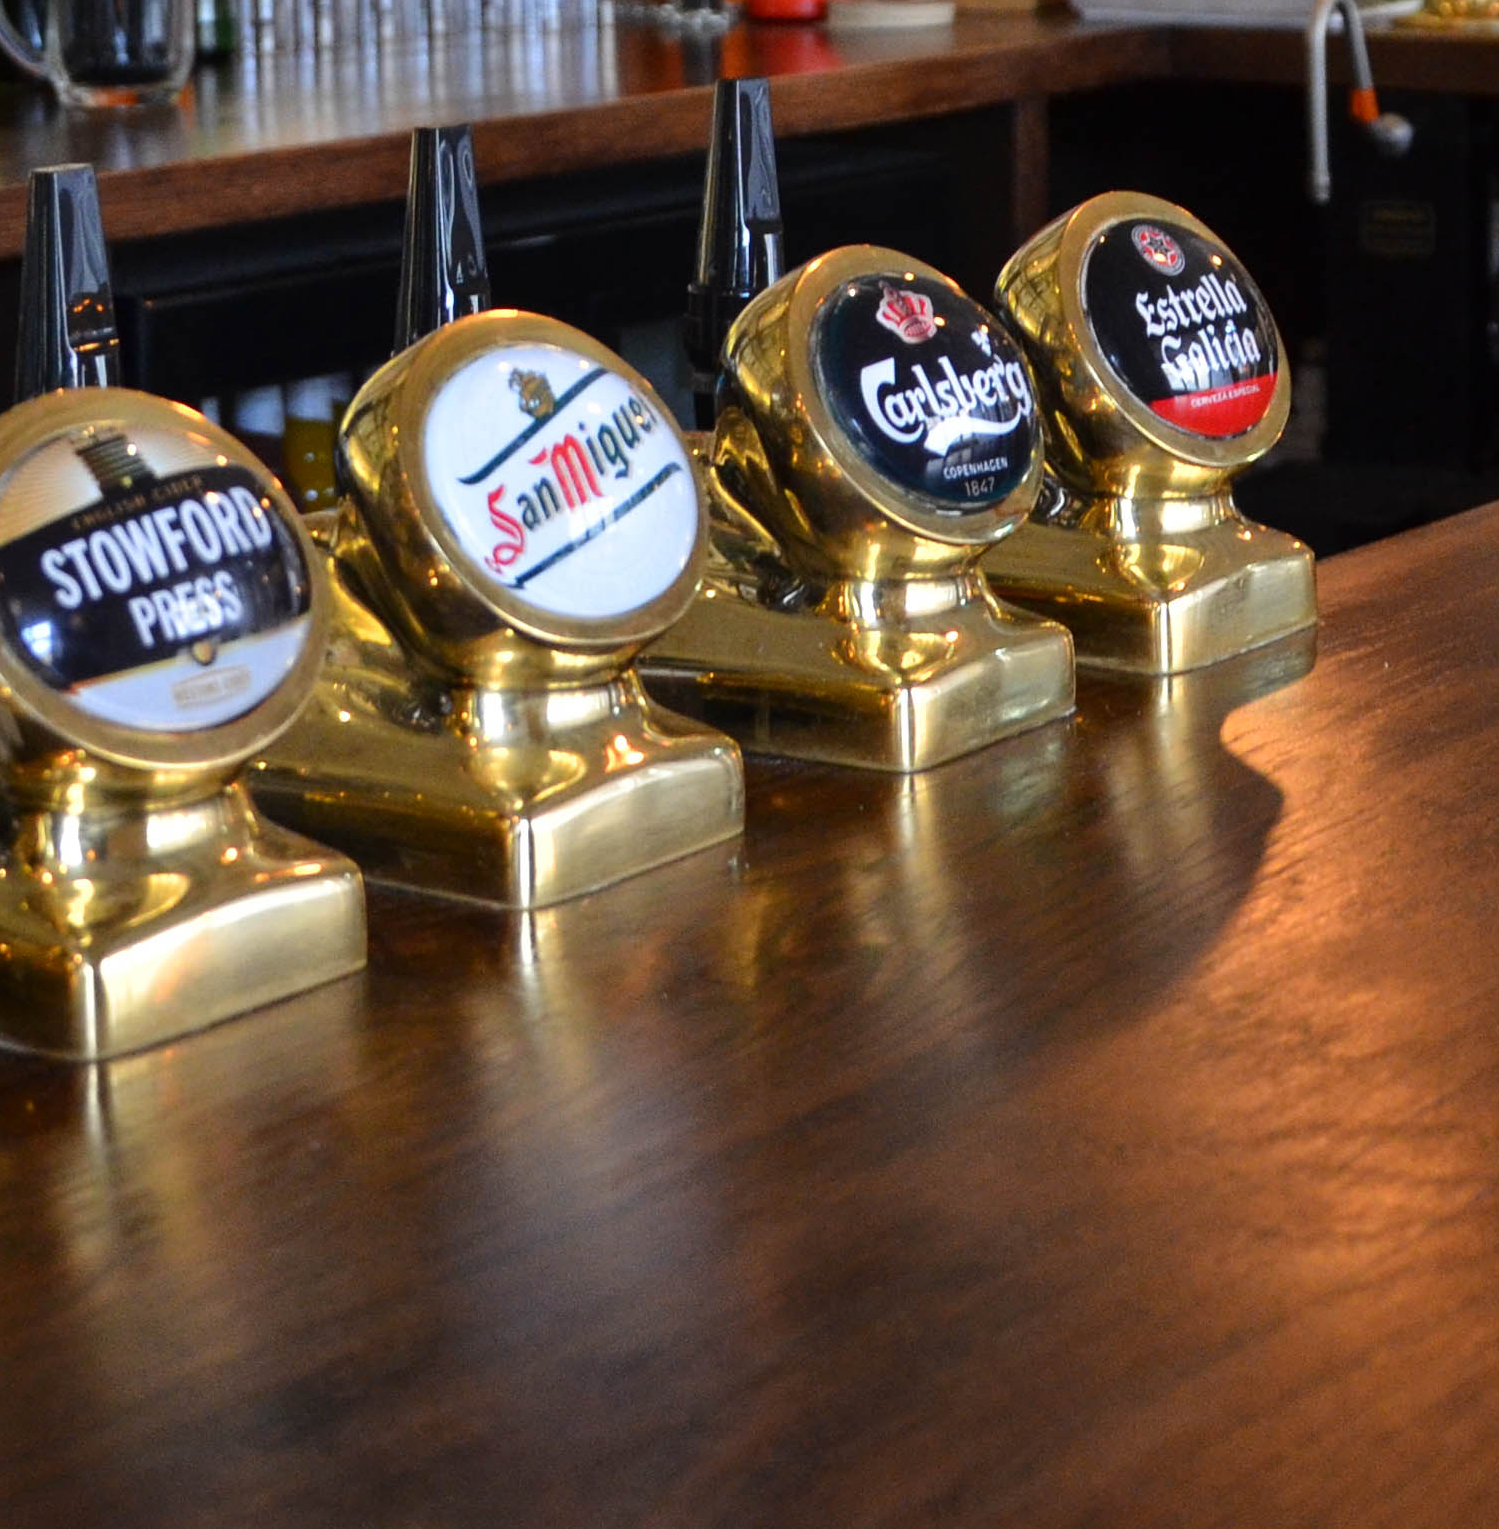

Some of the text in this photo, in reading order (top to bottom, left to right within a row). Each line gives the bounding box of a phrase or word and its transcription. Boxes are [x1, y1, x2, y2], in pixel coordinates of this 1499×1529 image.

[1135, 273, 1248, 339] Estrella
[1160, 320, 1262, 383] Galicia
[859, 354, 1036, 446] Carlsberg
[1190, 389, 1228, 409] CERVEZA
[484, 393, 659, 575] San Miguel
[943, 456, 1009, 481] COPENHAGEN
[963, 476, 996, 498] 1847
[39, 485, 274, 611] STOWFORD
[127, 569, 245, 649] PRESS
